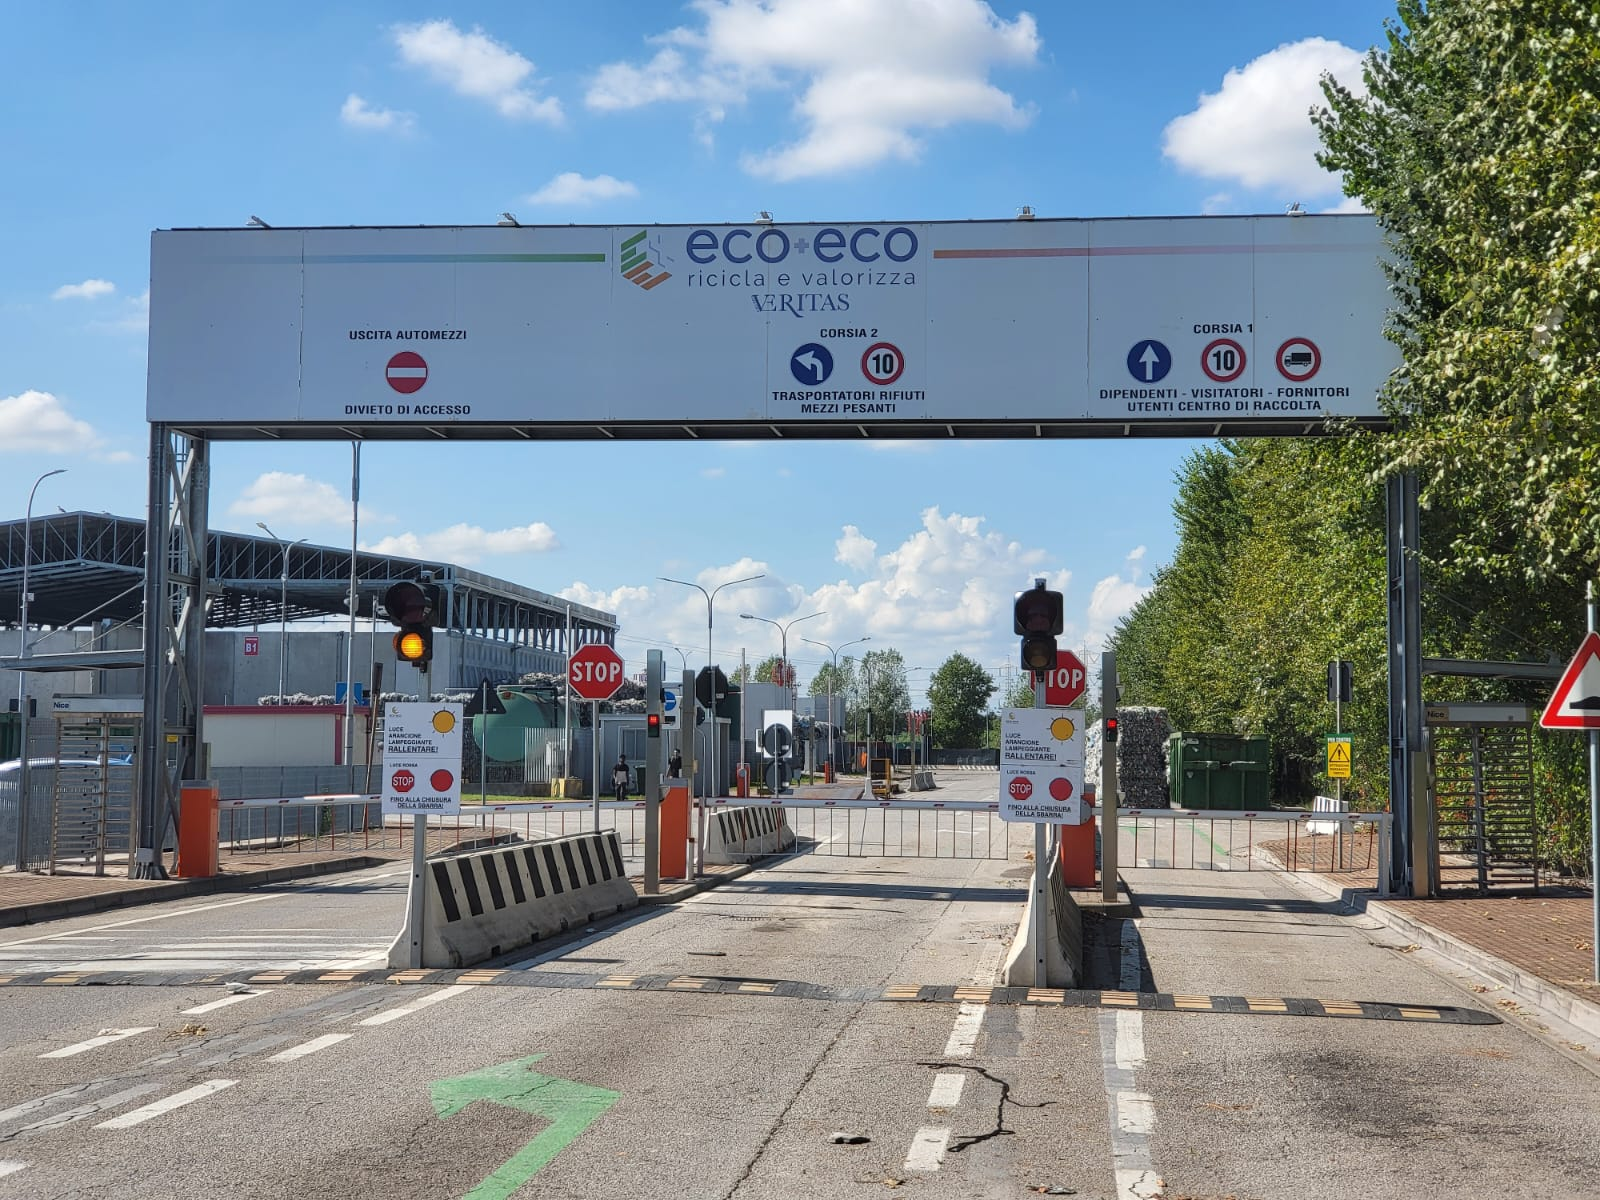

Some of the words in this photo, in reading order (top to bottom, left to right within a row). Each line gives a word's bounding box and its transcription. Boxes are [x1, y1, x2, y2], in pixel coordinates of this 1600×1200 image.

[688, 269, 765, 287] ricicla
[778, 272, 791, 286] e
[802, 269, 916, 286] valorizza
[752, 293, 850, 318] VERITAS
[820, 328, 867, 338] CORSIA
[871, 328, 879, 338] 2
[1193, 323, 1242, 334] CORSIA
[1247, 323, 1254, 333] 1
[349, 330, 392, 340] USCITA
[396, 330, 467, 340] AUTOMEZZI
[872, 352, 895, 374] 10
[1212, 350, 1236, 371] 10
[772, 391, 875, 401] TRASPORTATORI
[879, 391, 925, 401] RIFIUTI
[1100, 389, 1178, 399] DIPENDENTI
[1191, 388, 1264, 399] VISITATORI
[1277, 387, 1349, 397] FORNITORI
[345, 405, 393, 415] DIVIETO
[397, 405, 410, 415] DI
[414, 405, 471, 415] ACCESSO
[801, 404, 839, 413] MEZZI
[843, 403, 896, 413] PESANTI
[1127, 401, 1174, 412] UTENTI
[1178, 401, 1231, 411] CENTRO
[1235, 401, 1249, 411] DI
[1253, 400, 1322, 411] RACCOLTA
[246, 643, 257, 653] B1
[572, 661, 621, 682] STOP
[393, 777, 414, 786] STOP
[1010, 783, 1032, 794] STOP
